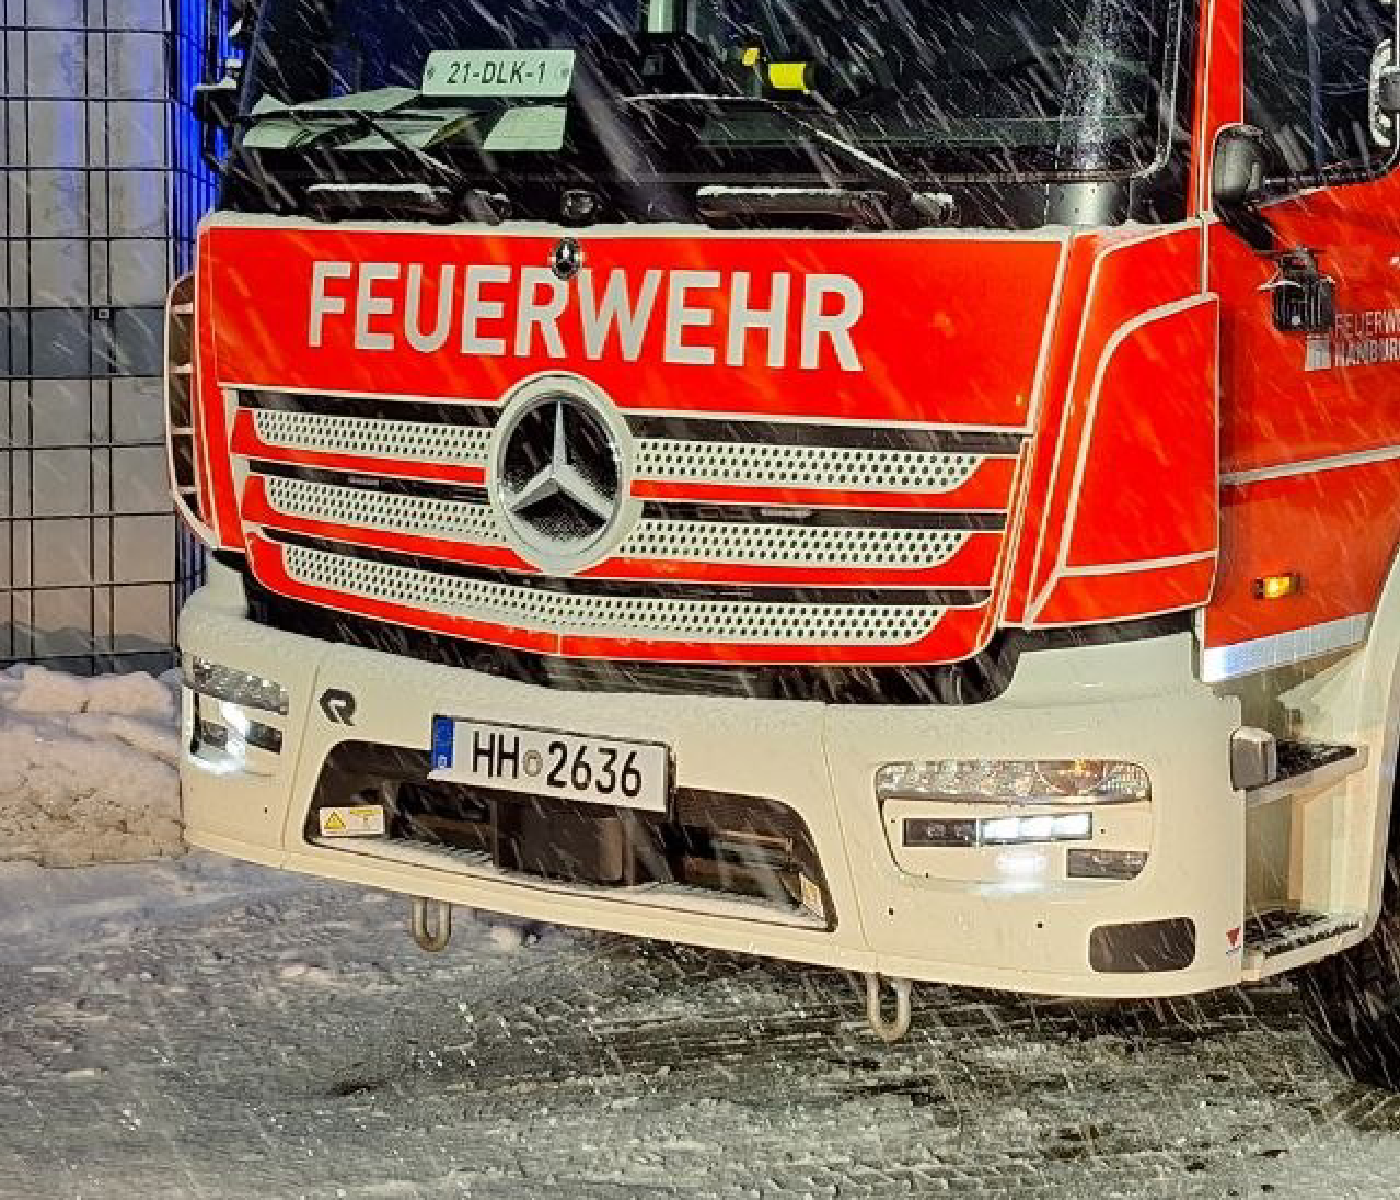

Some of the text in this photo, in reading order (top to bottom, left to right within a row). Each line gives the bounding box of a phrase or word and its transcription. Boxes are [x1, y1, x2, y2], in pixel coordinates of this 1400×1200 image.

[447, 60, 546, 84] 21-DLK-1
[308, 260, 864, 372] FEUERWEHR
[472, 730, 642, 797] HH 2636
